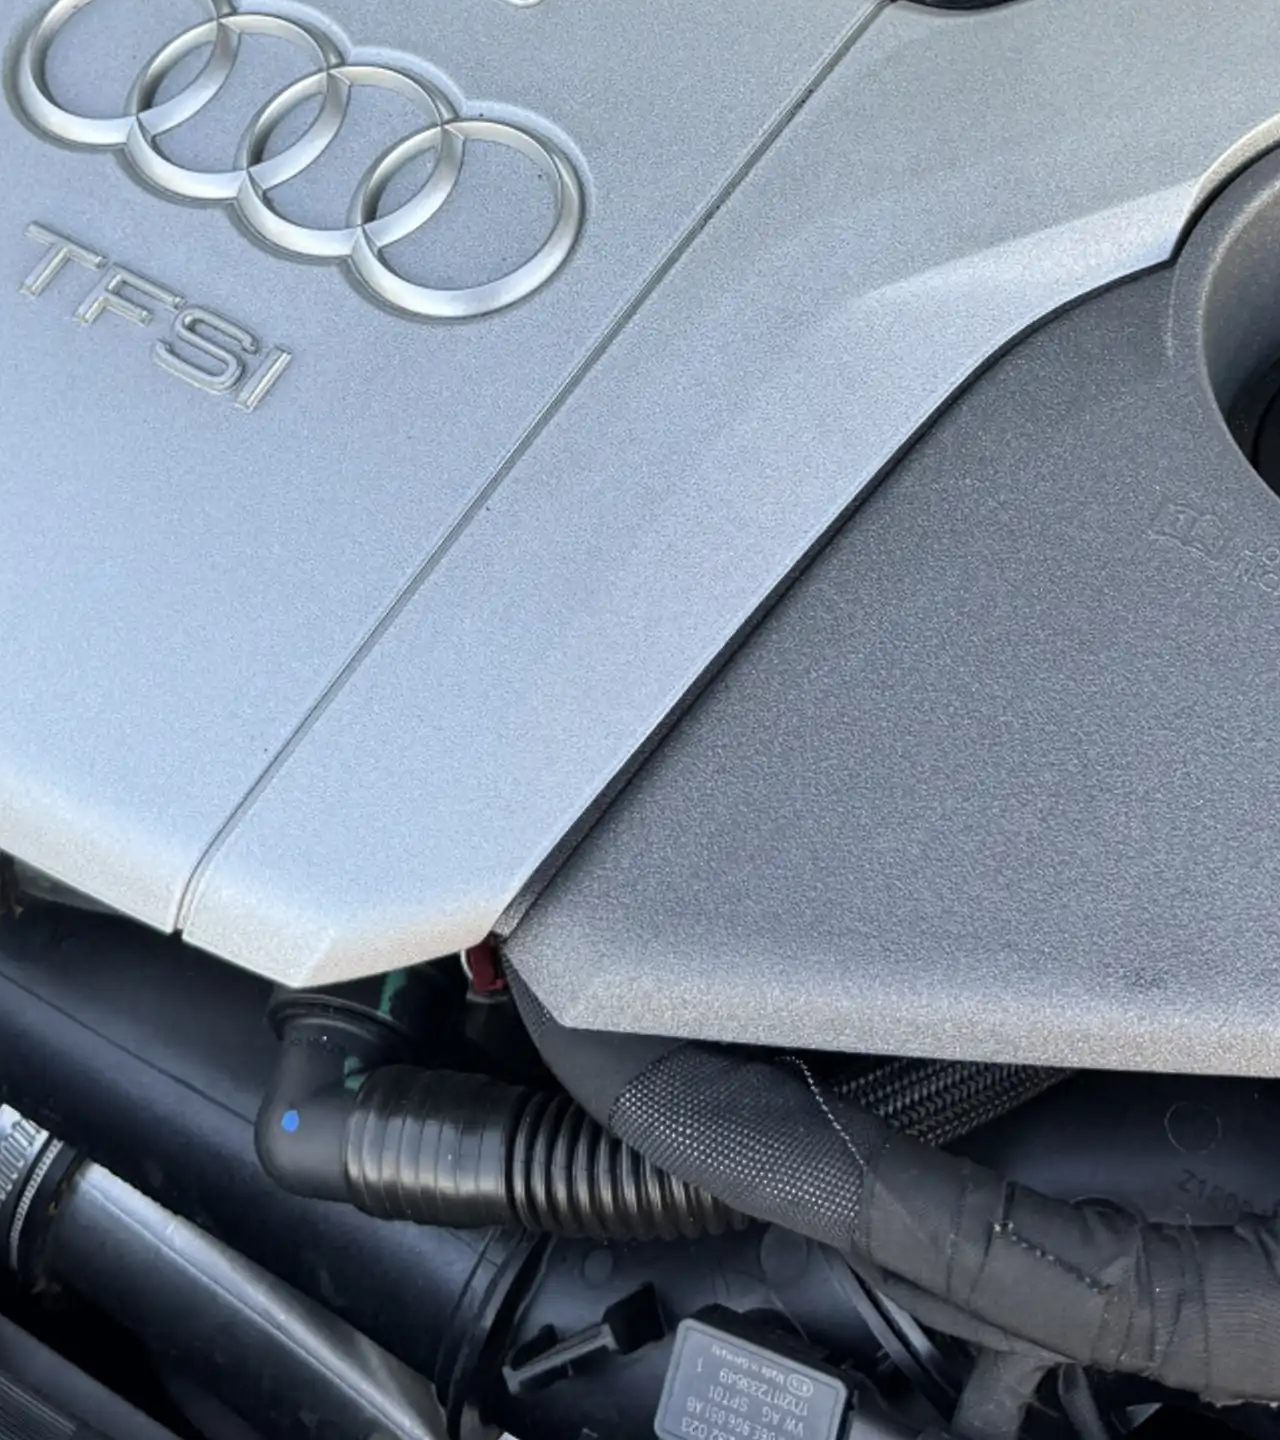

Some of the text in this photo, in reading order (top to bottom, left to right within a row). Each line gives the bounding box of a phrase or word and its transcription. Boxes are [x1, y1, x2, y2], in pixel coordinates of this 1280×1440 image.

[18, 220, 294, 414] TFSI
[680, 1416, 709, 1439] 023
[761, 1406, 781, 1426] AG
[784, 1414, 804, 1437] VW
